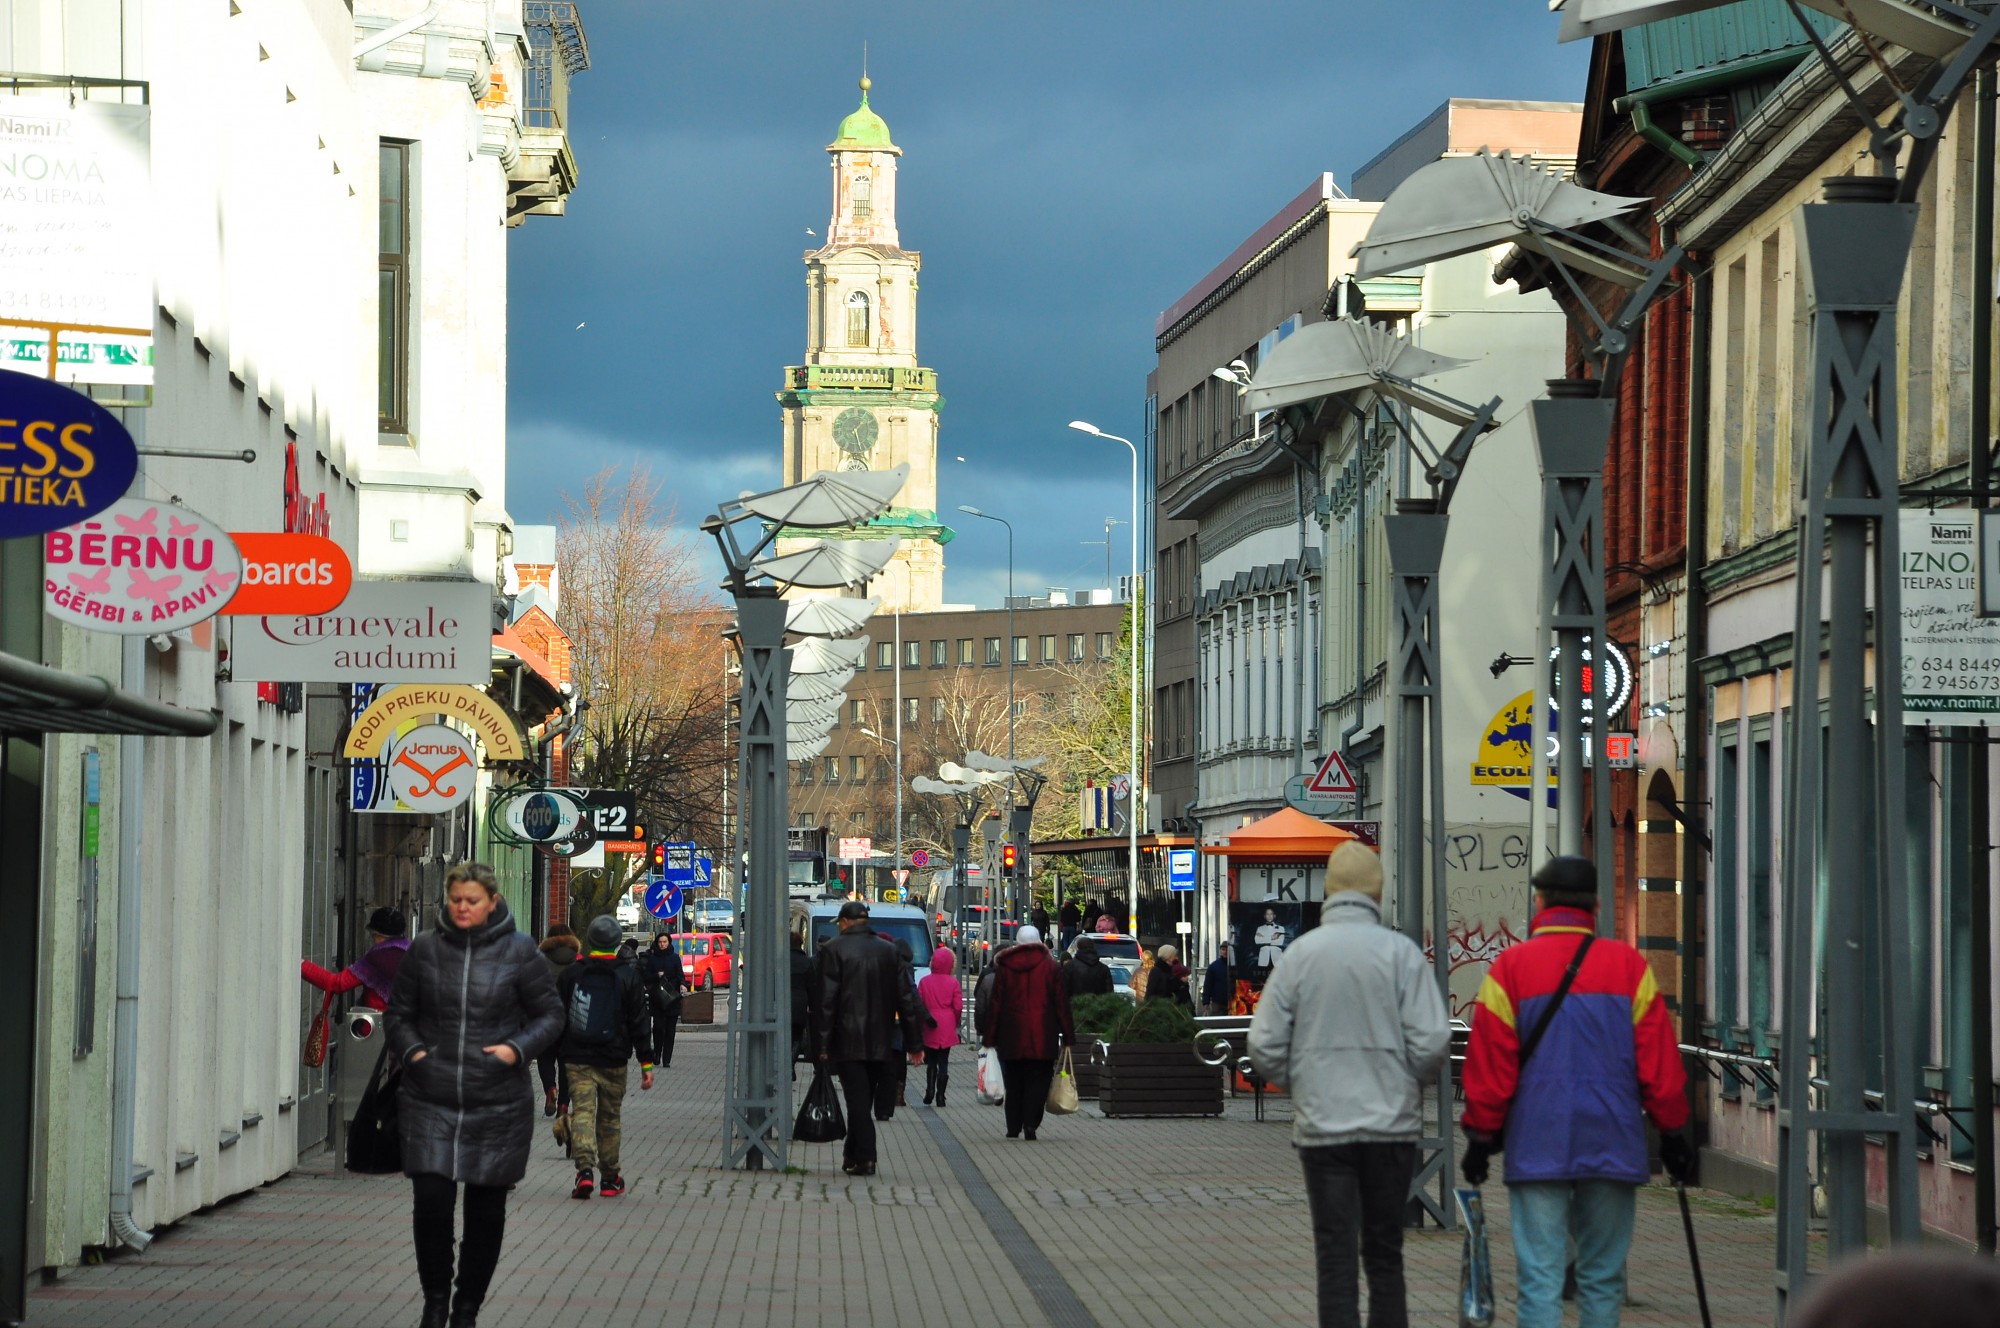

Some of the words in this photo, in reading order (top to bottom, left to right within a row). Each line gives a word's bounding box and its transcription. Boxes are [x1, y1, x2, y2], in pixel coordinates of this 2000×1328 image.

[46, 522, 214, 571] BĒRNU
[242, 558, 333, 585] bards
[1902, 552, 1975, 573] IZNO
[1901, 577, 1953, 590] TELPAS
[132, 610, 143, 622] &
[151, 583, 217, 622] APAVI
[261, 606, 458, 646] Carnevale
[334, 644, 457, 670] audumi
[1921, 656, 1953, 672] 634
[1959, 657, 2000, 673] 8449
[1922, 675, 1932, 689] 2
[1937, 675, 1999, 690] 945673
[353, 710, 386, 751] RODI
[386, 690, 450, 715] PRIEKU
[456, 695, 513, 755] DĀVINOT
[409, 742, 458, 755] Janus
[1328, 771, 1341, 785] M
[526, 807, 552, 827] FOTO
